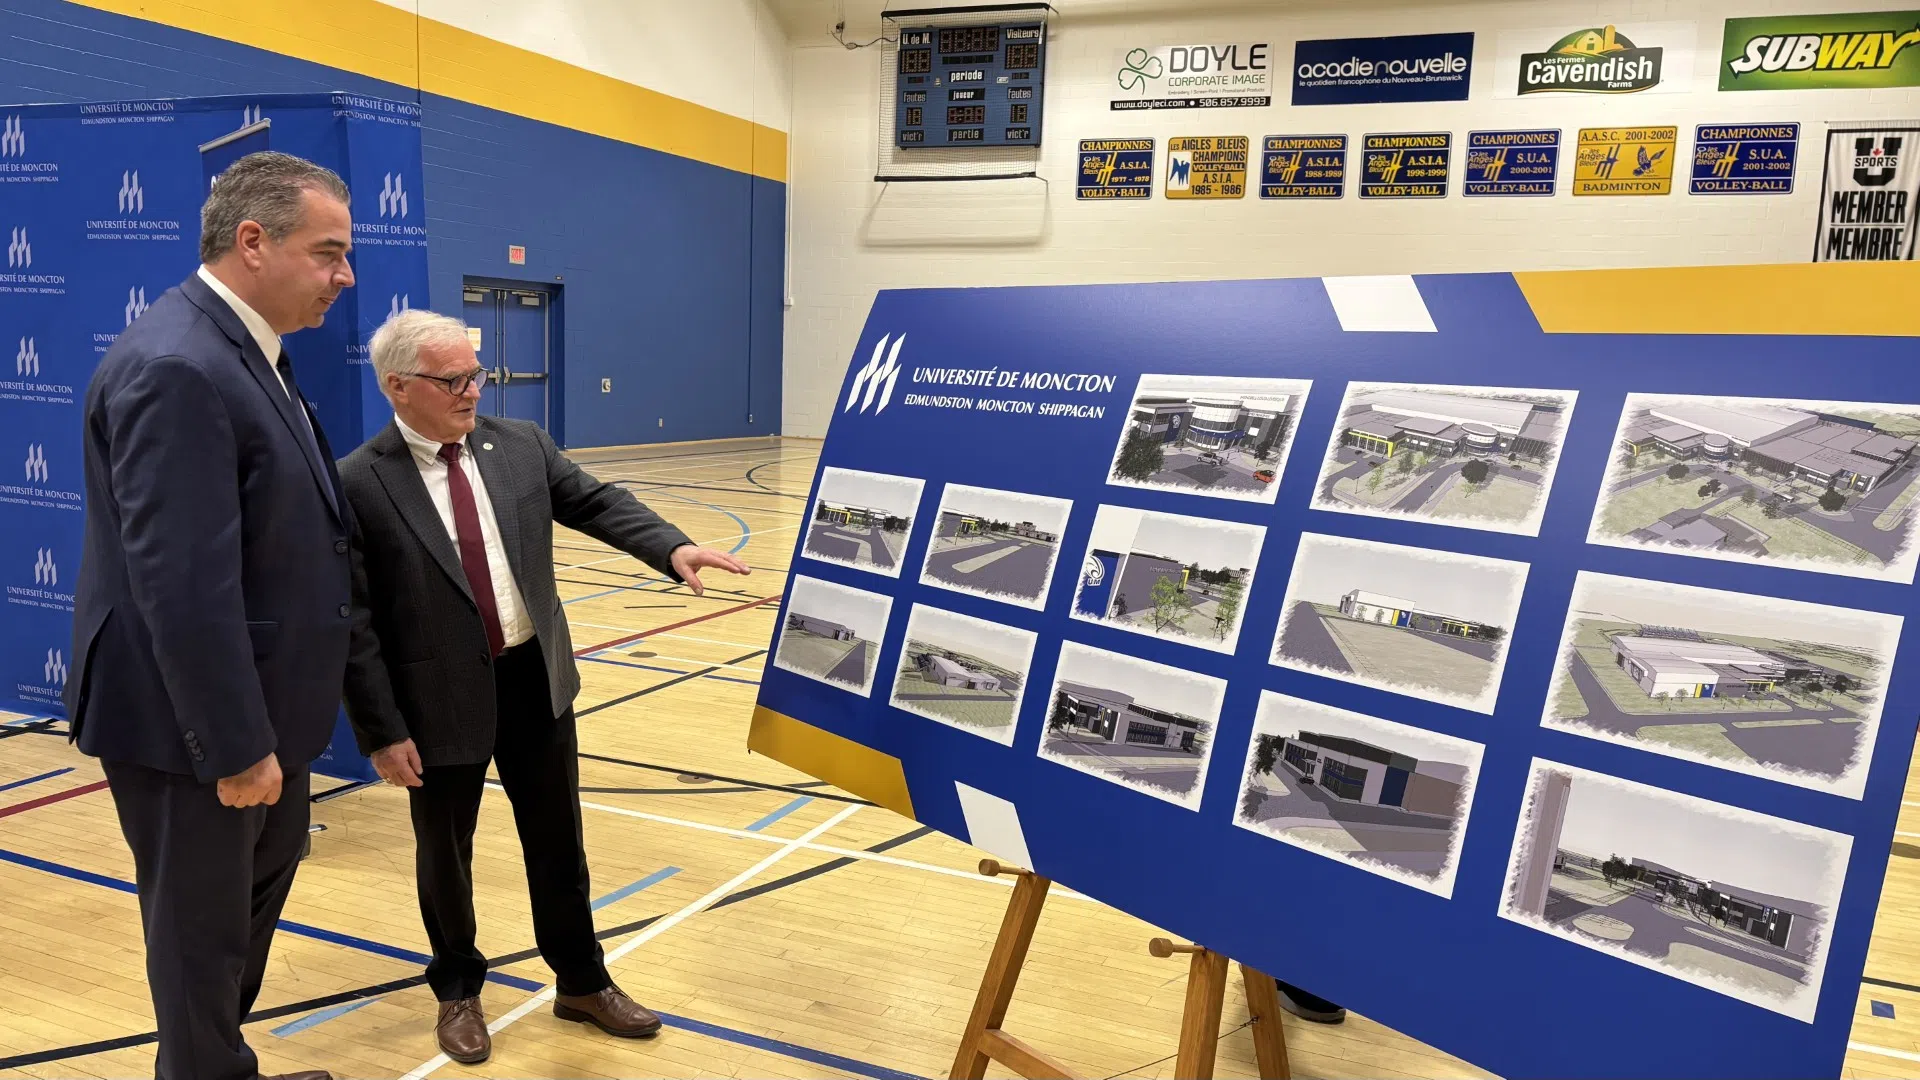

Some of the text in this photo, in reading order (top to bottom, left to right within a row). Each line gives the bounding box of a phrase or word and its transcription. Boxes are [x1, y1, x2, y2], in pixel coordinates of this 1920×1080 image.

[910, 34, 920, 44] de
[1006, 28, 1040, 39] Visiteurs
[1729, 31, 1910, 74] SUBWAY
[1169, 44, 1268, 73] DOYLE
[1556, 56, 1586, 64] Fermes
[1526, 56, 1653, 85] Cavendish
[1168, 73, 1266, 87] CORPORATE IMAGE
[1306, 78, 1337, 87] quotidien
[1337, 77, 1382, 87] francophone
[1382, 76, 1391, 84] du
[1391, 73, 1463, 84] Nouveau-Brunswick
[903, 92, 926, 103] fautes
[952, 90, 975, 101] joueur
[1008, 88, 1032, 100] fautes
[80, 101, 174, 114] UNIVERSITÉ DE MONCTON
[332, 95, 383, 111] UNIVERSITÉ
[383, 103, 396, 113] DE
[1114, 97, 1266, 110] www.doyleci.com 506.857.9993
[81, 115, 175, 125] EDMUNDSTON MONCTON SHIPPAGAN
[377, 116, 409, 126] MONCTON
[952, 130, 979, 142] partie
[1472, 133, 1556, 145] CHAMPIONNES
[1580, 130, 1674, 142] A.A.S.C. 2001-2002
[1700, 127, 1794, 140] CHAMPIONNES
[1081, 140, 1152, 151] CHAMPIONNES
[1181, 139, 1211, 151] AIGLES
[1216, 138, 1246, 150] BLEUS
[1268, 139, 1343, 149] CHAMPIONNES
[1367, 136, 1447, 148] CHAMPIONNES
[1192, 151, 1246, 162] CHAMPIONS
[1516, 152, 1551, 163] S.U.A.
[1579, 152, 1606, 162] Anges
[1696, 151, 1724, 160] Anges
[1749, 149, 1787, 160] S.U.A.
[1082, 161, 1105, 169] Anges
[1119, 161, 1150, 170] A.S.I.A.
[1268, 160, 1290, 169] Anges
[1305, 157, 1343, 167] A.S.I.A.
[1368, 160, 1391, 168] Anges
[1407, 156, 1446, 166] A.S.I.A.
[1468, 156, 1494, 166] Anges
[1696, 158, 1716, 166] Bleus
[1742, 162, 1791, 171] 2001-2002
[1853, 137, 1903, 186] U
[1854, 156, 1898, 168] SPORTS
[10, 163, 20, 172] DE
[20, 163, 59, 172] MONCTON
[1193, 163, 1245, 172] VOLLEY-BALL
[1510, 166, 1552, 174] 2000-2001
[1202, 173, 1235, 184] A.S.I.A.
[1305, 170, 1343, 178] 1988-1989
[1407, 169, 1447, 178] 1998-1999
[1191, 185, 1212, 195] 1985
[1220, 184, 1242, 195] 1986
[1367, 186, 1440, 196] VOLLEY-BALL
[1469, 183, 1550, 193] VOLLEY-BALL
[1583, 182, 1661, 192] BADMINTON
[1695, 180, 1787, 191] VOLLEY-BALL
[1267, 187, 1336, 196] VOLLEY-BALL
[1831, 190, 1909, 224] MEMBER
[86, 219, 180, 230] UNIVERSITÉ DE MONCTON
[353, 222, 390, 234] IVERSITÉ
[390, 225, 402, 235] DE
[352, 237, 383, 246] UNDSTON
[384, 239, 415, 247] MONCTON
[1825, 227, 1905, 262] MEMBRE
[17, 274, 27, 283] DE
[28, 275, 65, 284] MONCTON
[912, 366, 1117, 393] UNIVERSITÉ DE MONCTON
[0, 380, 73, 394] VERSITÉ DE MONCTON
[904, 394, 1106, 419] EDMUNDSTON MONCTON SHIPPAGAN
[34, 488, 44, 497] DE
[44, 489, 82, 501] MONCTON
[30, 500, 55, 508] MONCTON
[56, 502, 82, 511] SHIPPAGAN
[7, 585, 76, 603] UNIVERSITÉ DE MONC
[39, 602, 65, 611] MONCTON
[17, 683, 54, 697] UNIVERSITÉ
